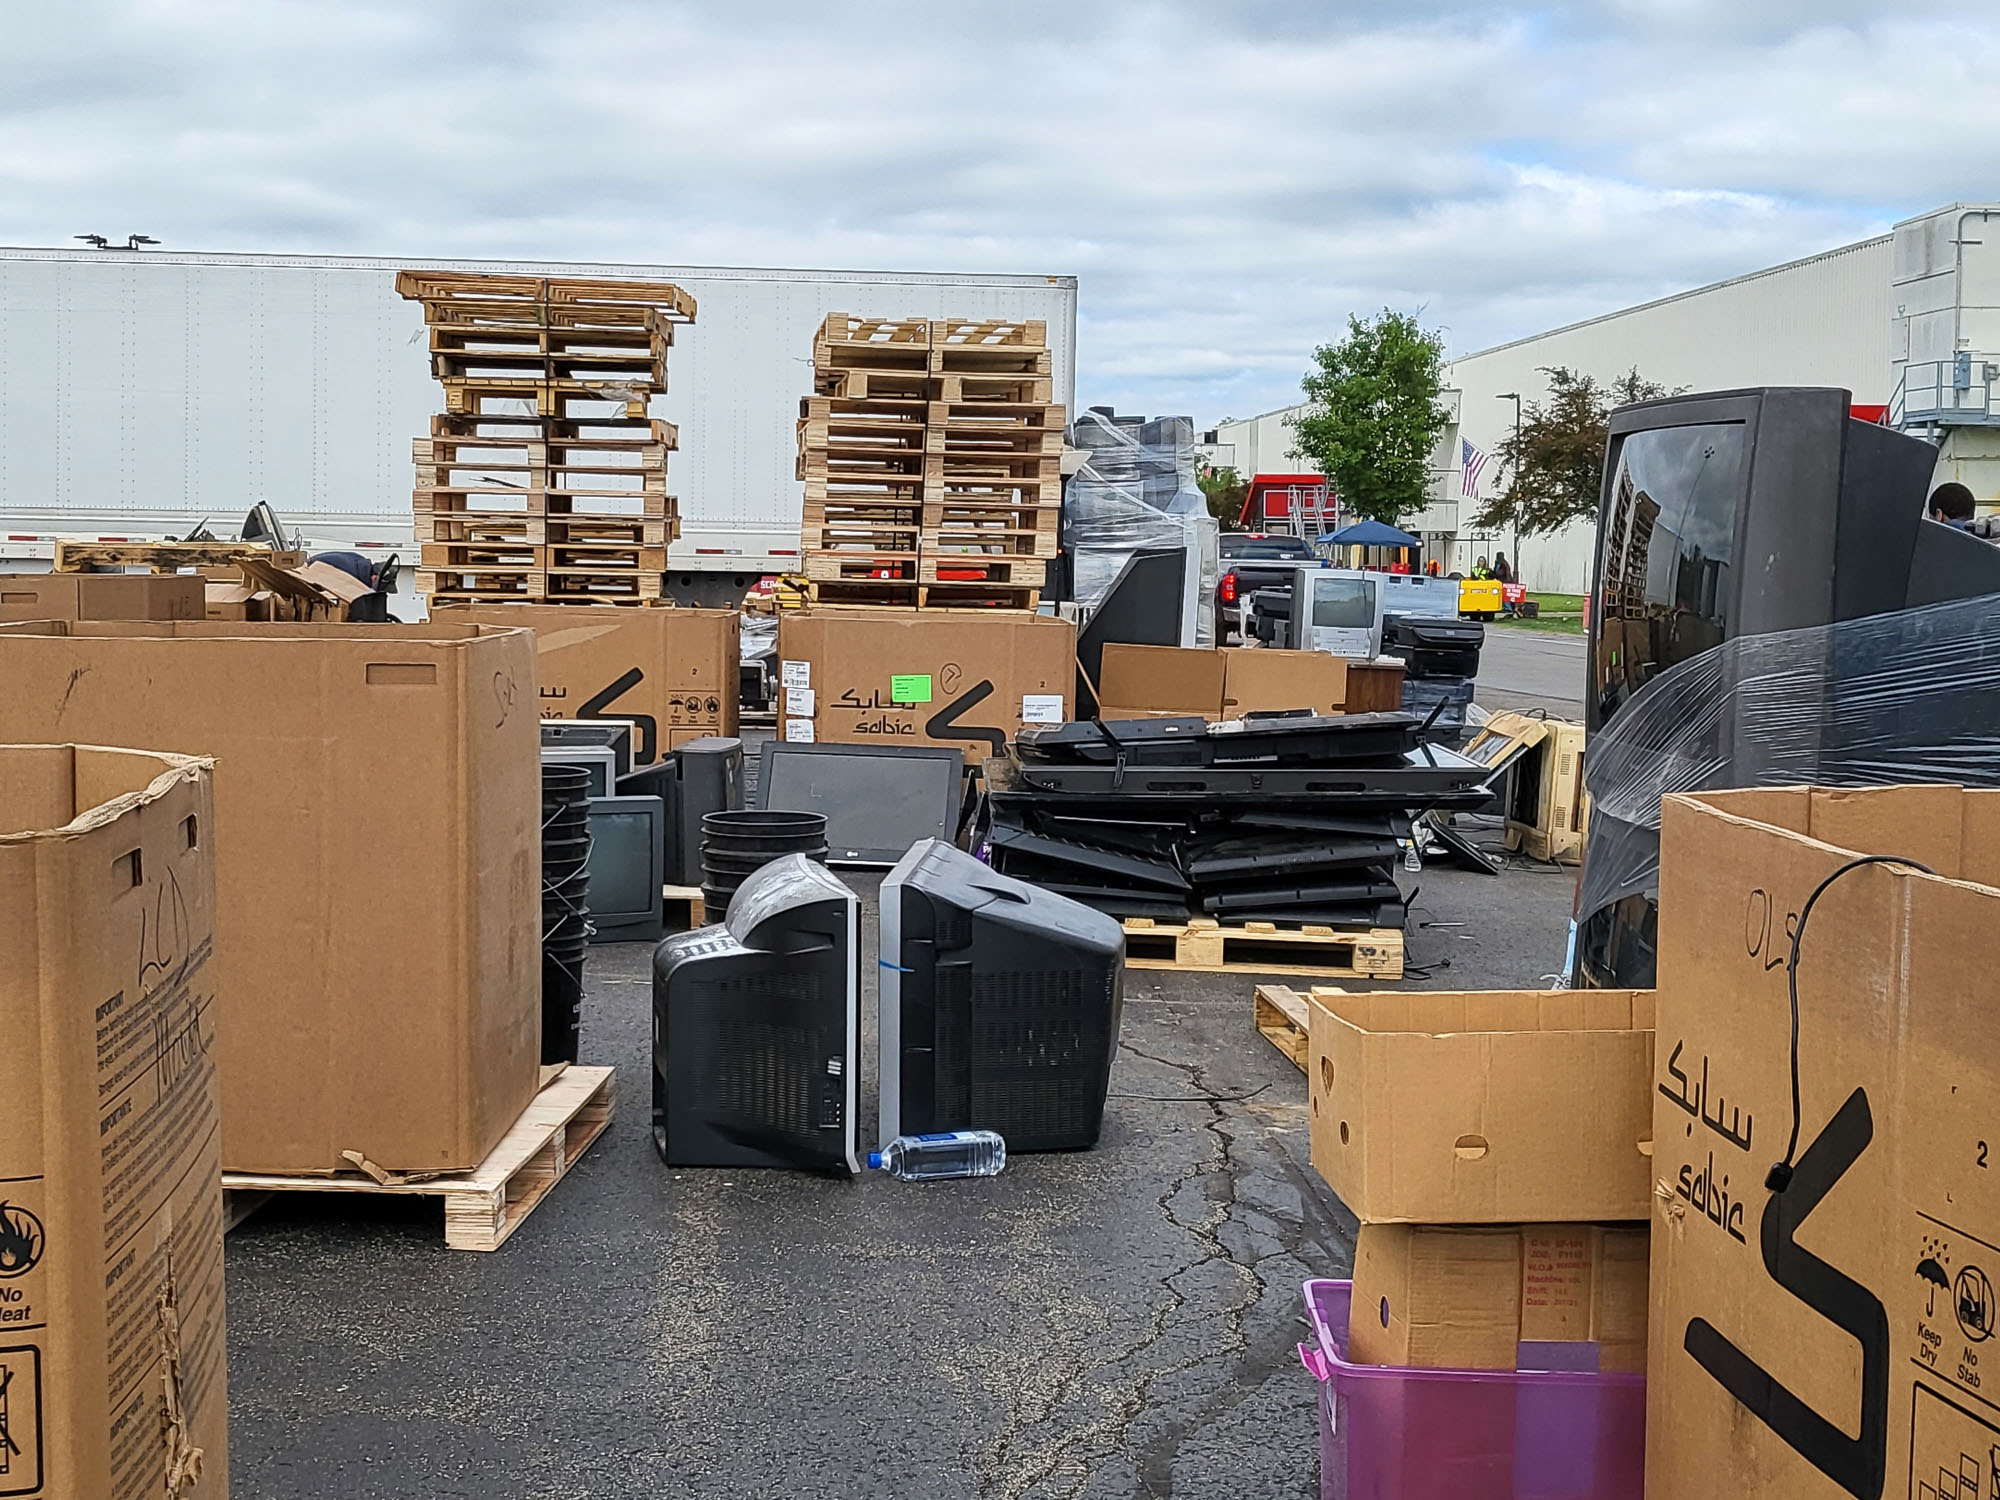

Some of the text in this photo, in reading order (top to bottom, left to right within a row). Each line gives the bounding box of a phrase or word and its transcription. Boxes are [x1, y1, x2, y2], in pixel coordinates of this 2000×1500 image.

[1039, 680, 1046, 688] 2
[853, 715, 916, 735] sabic
[1658, 1039, 1752, 1152] سابك
[1976, 1140, 1988, 1169] 2
[1676, 1150, 1747, 1246] sabic
[0, 1287, 23, 1302] No
[1918, 1322, 1942, 1349] Keep
[1920, 1343, 1937, 1367] Dry
[1963, 1346, 1978, 1366] No
[1957, 1364, 1981, 1388] Stab
